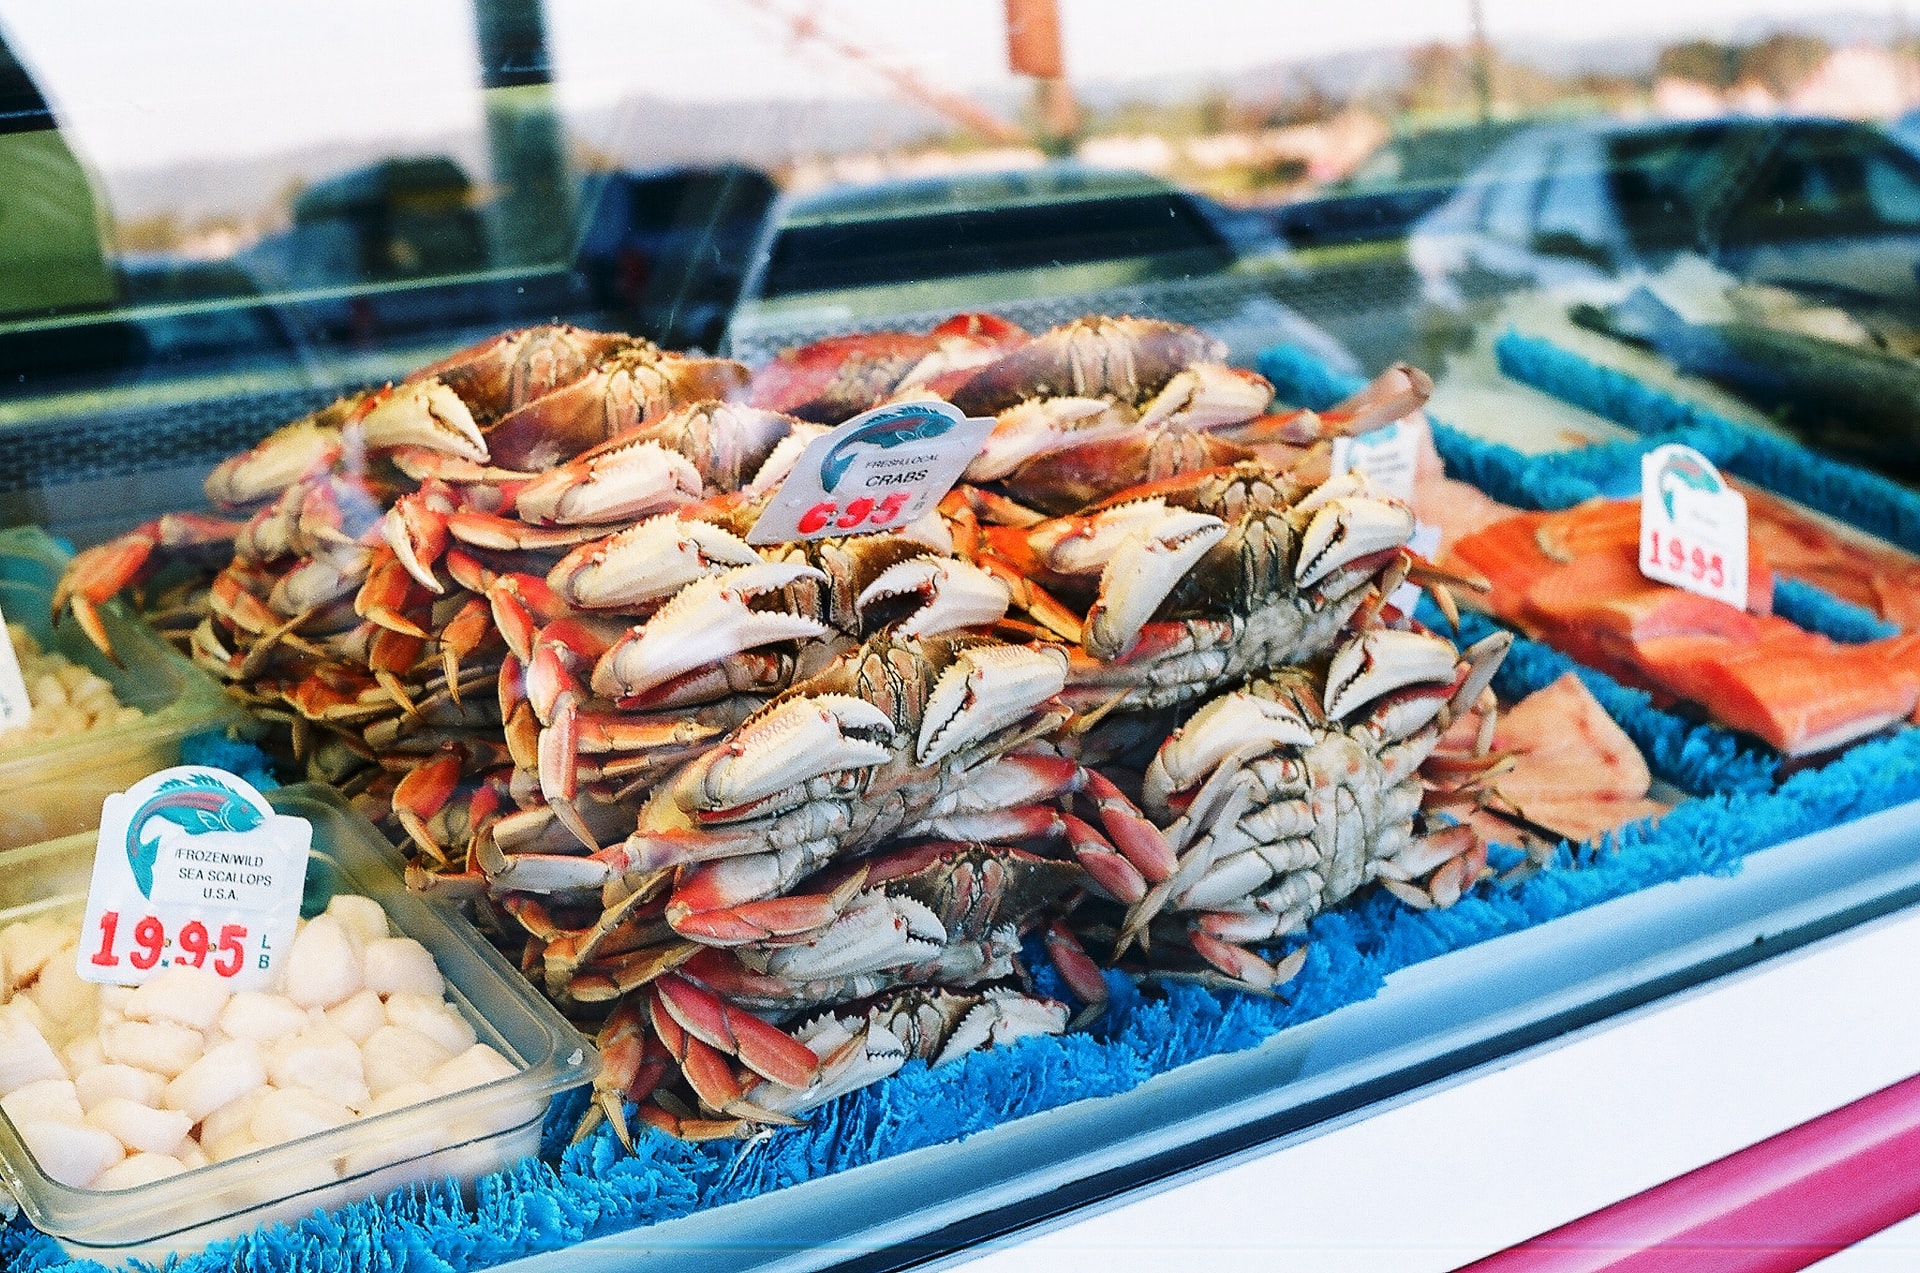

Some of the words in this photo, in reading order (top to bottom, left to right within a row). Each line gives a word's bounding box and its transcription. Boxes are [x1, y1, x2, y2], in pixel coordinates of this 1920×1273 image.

[865, 469, 929, 488] CRABS
[178, 867, 204, 881] SEA
[207, 869, 272, 887] SCALLOPS
[202, 887, 239, 901] U.S.A.
